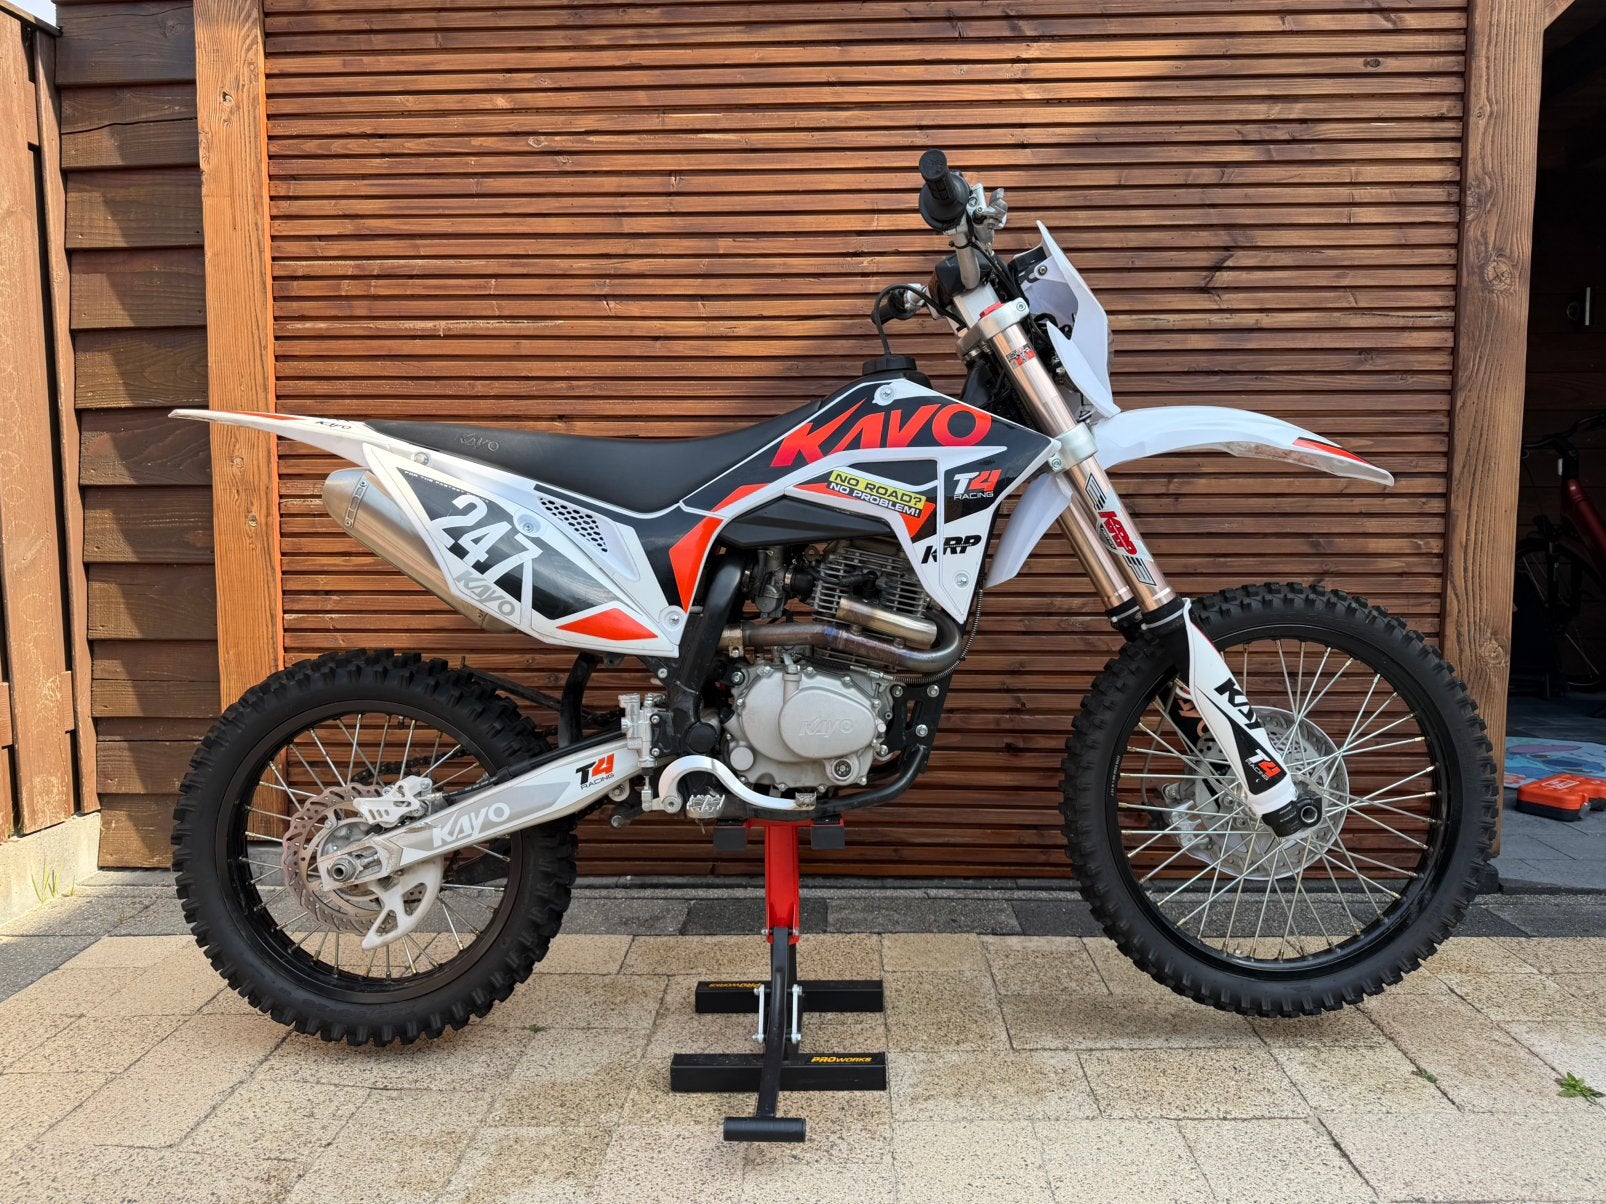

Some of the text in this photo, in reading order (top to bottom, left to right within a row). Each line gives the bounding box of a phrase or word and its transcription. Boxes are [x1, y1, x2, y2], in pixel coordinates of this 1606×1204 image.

[834, 473, 923, 507] NO ROAD?
[953, 469, 1002, 495] T4
[953, 491, 994, 501] RACING
[829, 482, 920, 517] NO PROBLEM!
[429, 494, 544, 584] 247
[921, 534, 982, 565] KRP
[454, 569, 516, 617] KAYO
[575, 752, 615, 785] T4
[1245, 748, 1282, 779] T4
[580, 772, 615, 791] RACING
[432, 802, 511, 848] KAYO
